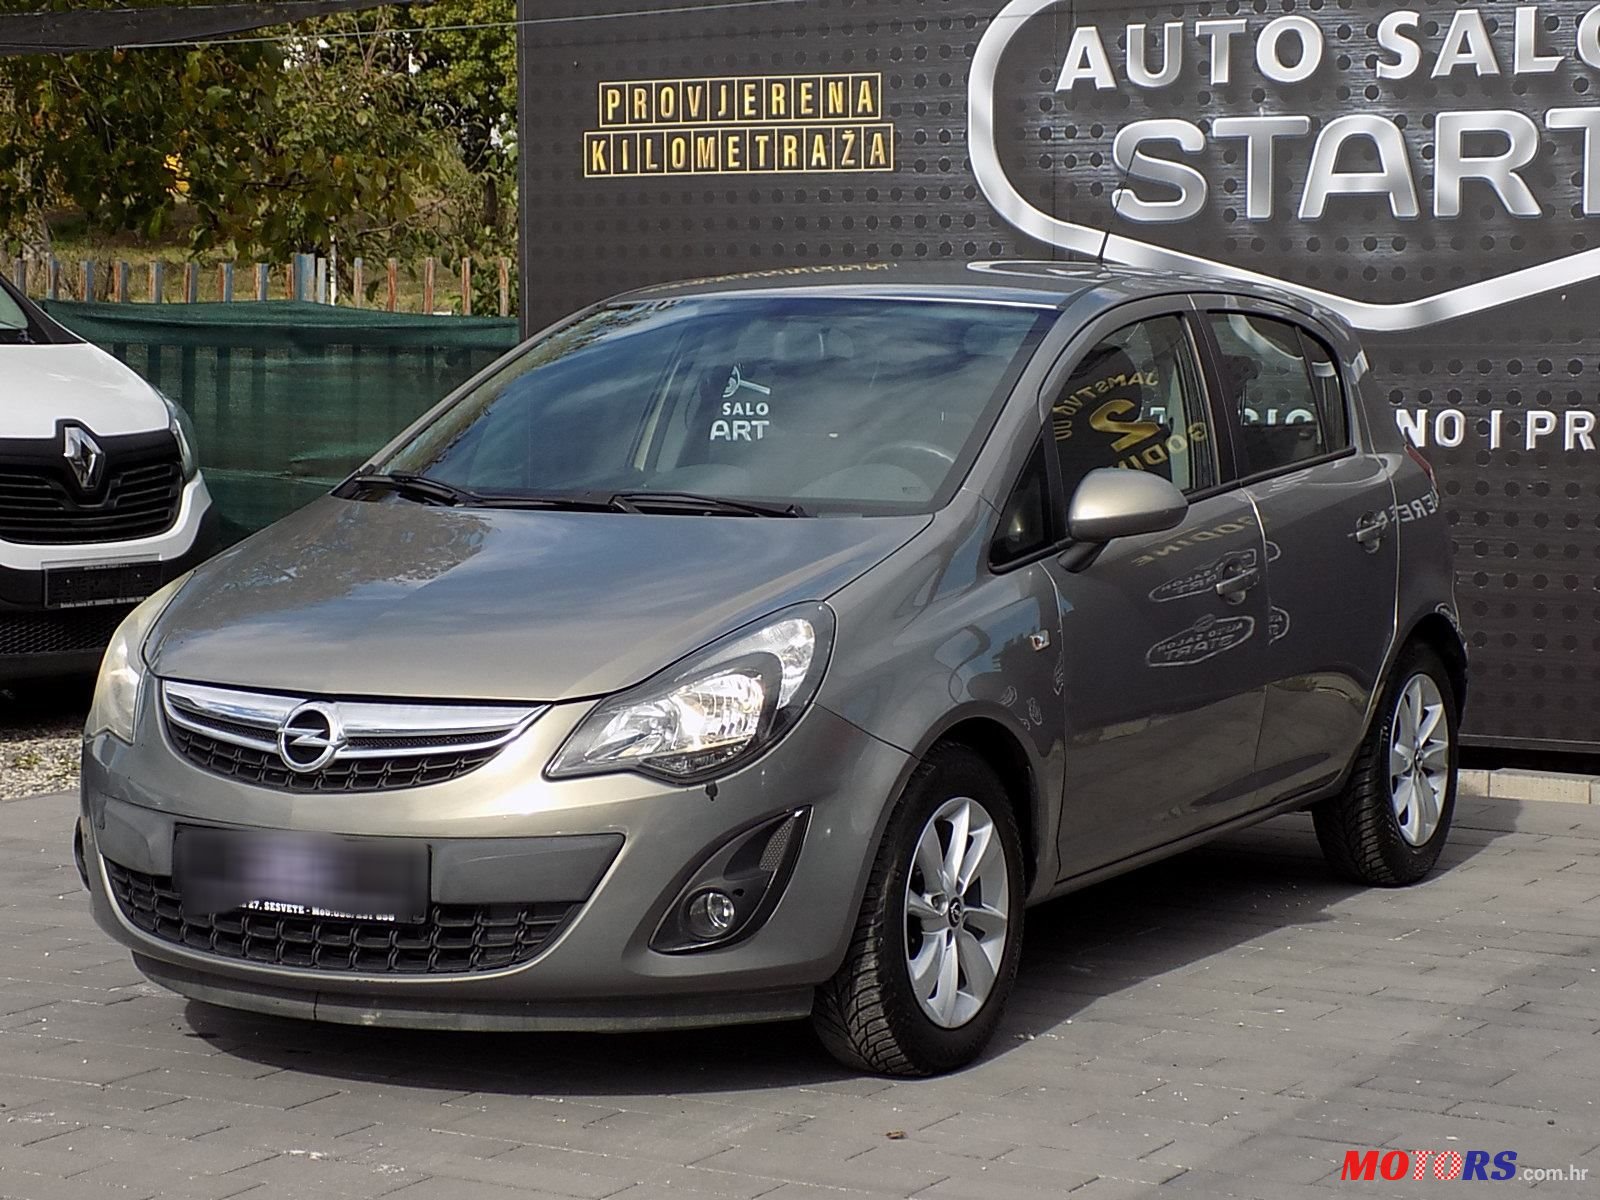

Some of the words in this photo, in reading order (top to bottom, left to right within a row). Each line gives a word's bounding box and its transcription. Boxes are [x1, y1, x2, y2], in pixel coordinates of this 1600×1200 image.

[1055, 15, 1323, 92] AUTO
[607, 80, 874, 120] PROVJERENA
[591, 130, 887, 172] KILOMETRAŽA
[722, 402, 769, 416] SALO
[710, 420, 770, 441] ART
[1526, 410, 1597, 451] PR
